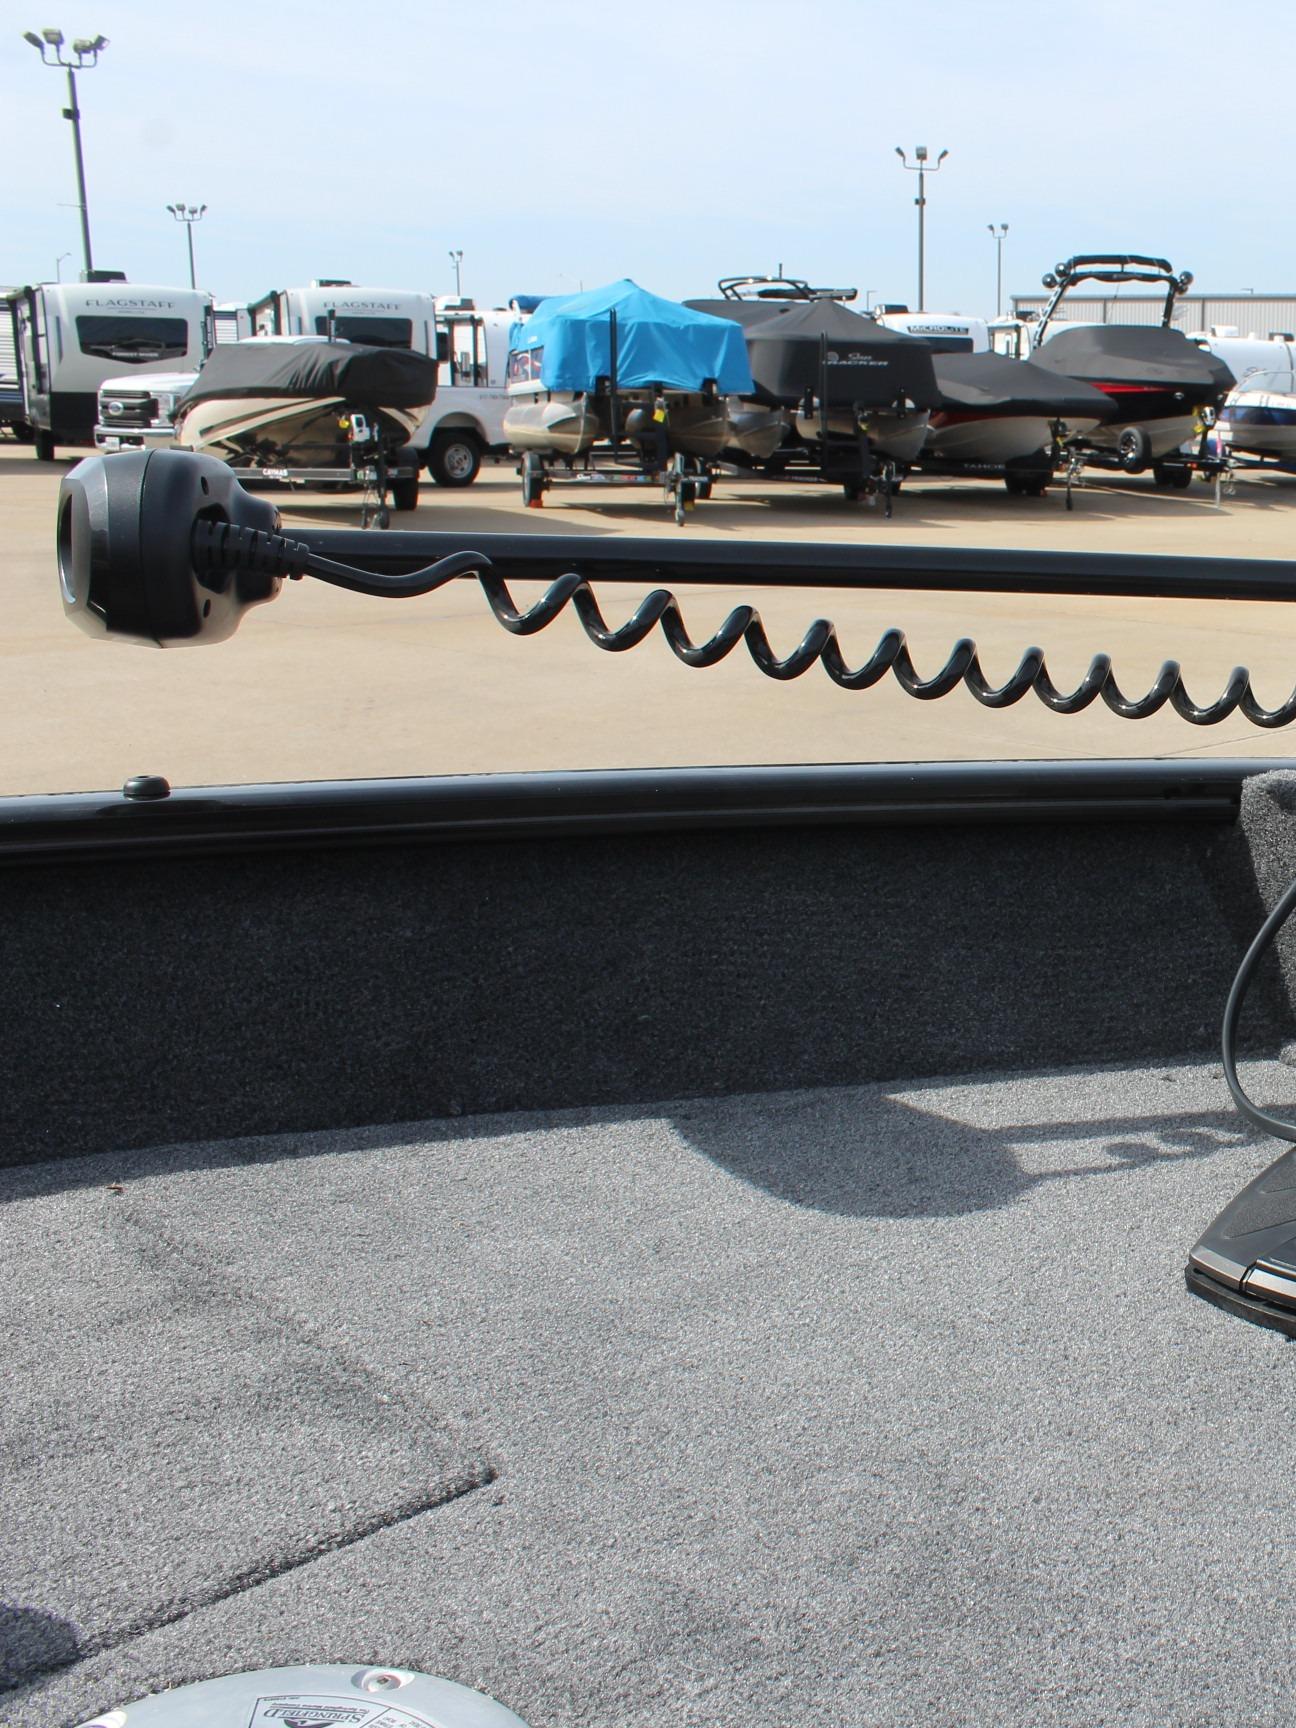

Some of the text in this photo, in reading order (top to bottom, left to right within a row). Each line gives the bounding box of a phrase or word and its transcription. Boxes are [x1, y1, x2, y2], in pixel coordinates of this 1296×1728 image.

[85, 299, 175, 309] FLAGSTAFF
[323, 301, 401, 311] FLAGSTAFF
[264, 1708, 365, 1724] SPRINGFIELD
